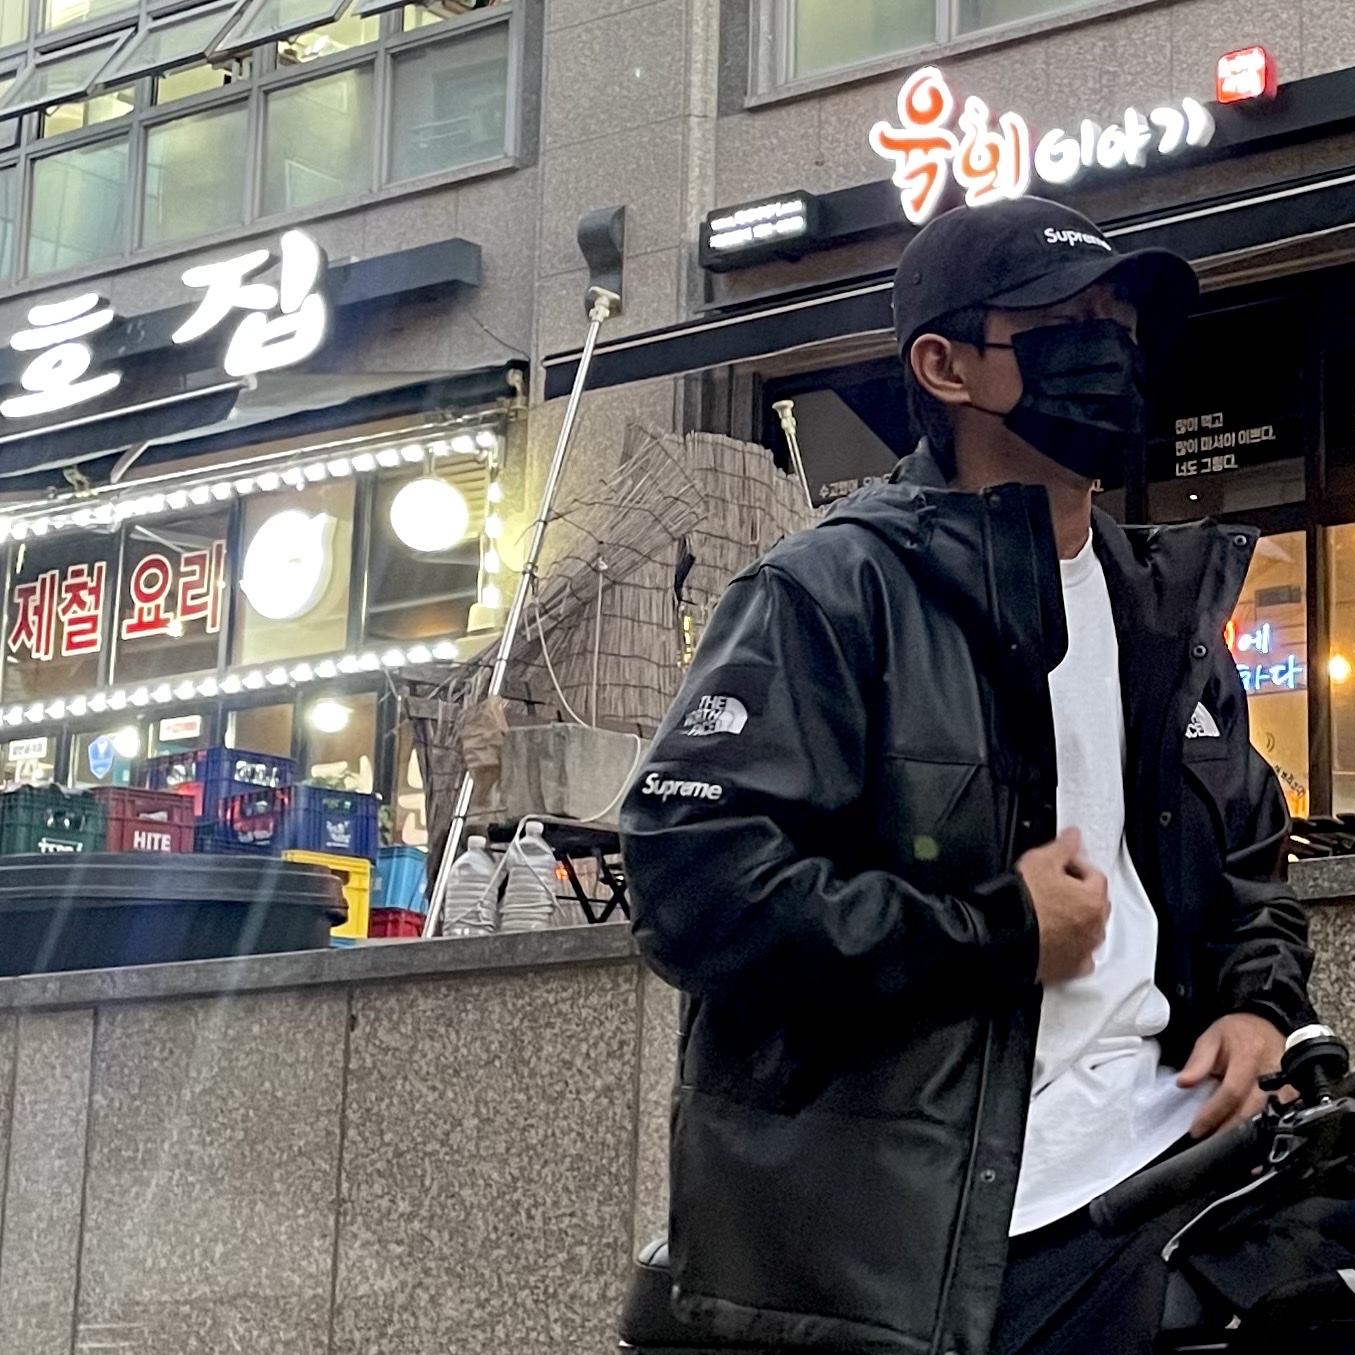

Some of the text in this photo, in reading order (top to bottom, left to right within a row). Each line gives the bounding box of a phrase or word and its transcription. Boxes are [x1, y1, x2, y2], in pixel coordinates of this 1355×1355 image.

[1175, 416, 1199, 434] 많이
[1175, 437, 1198, 456] 많이
[1175, 460, 1198, 476] 너도
[8, 539, 226, 661] 제철 요리
[699, 695, 728, 711] THE
[641, 772, 723, 803] Supreme
[133, 830, 172, 852] HITE
